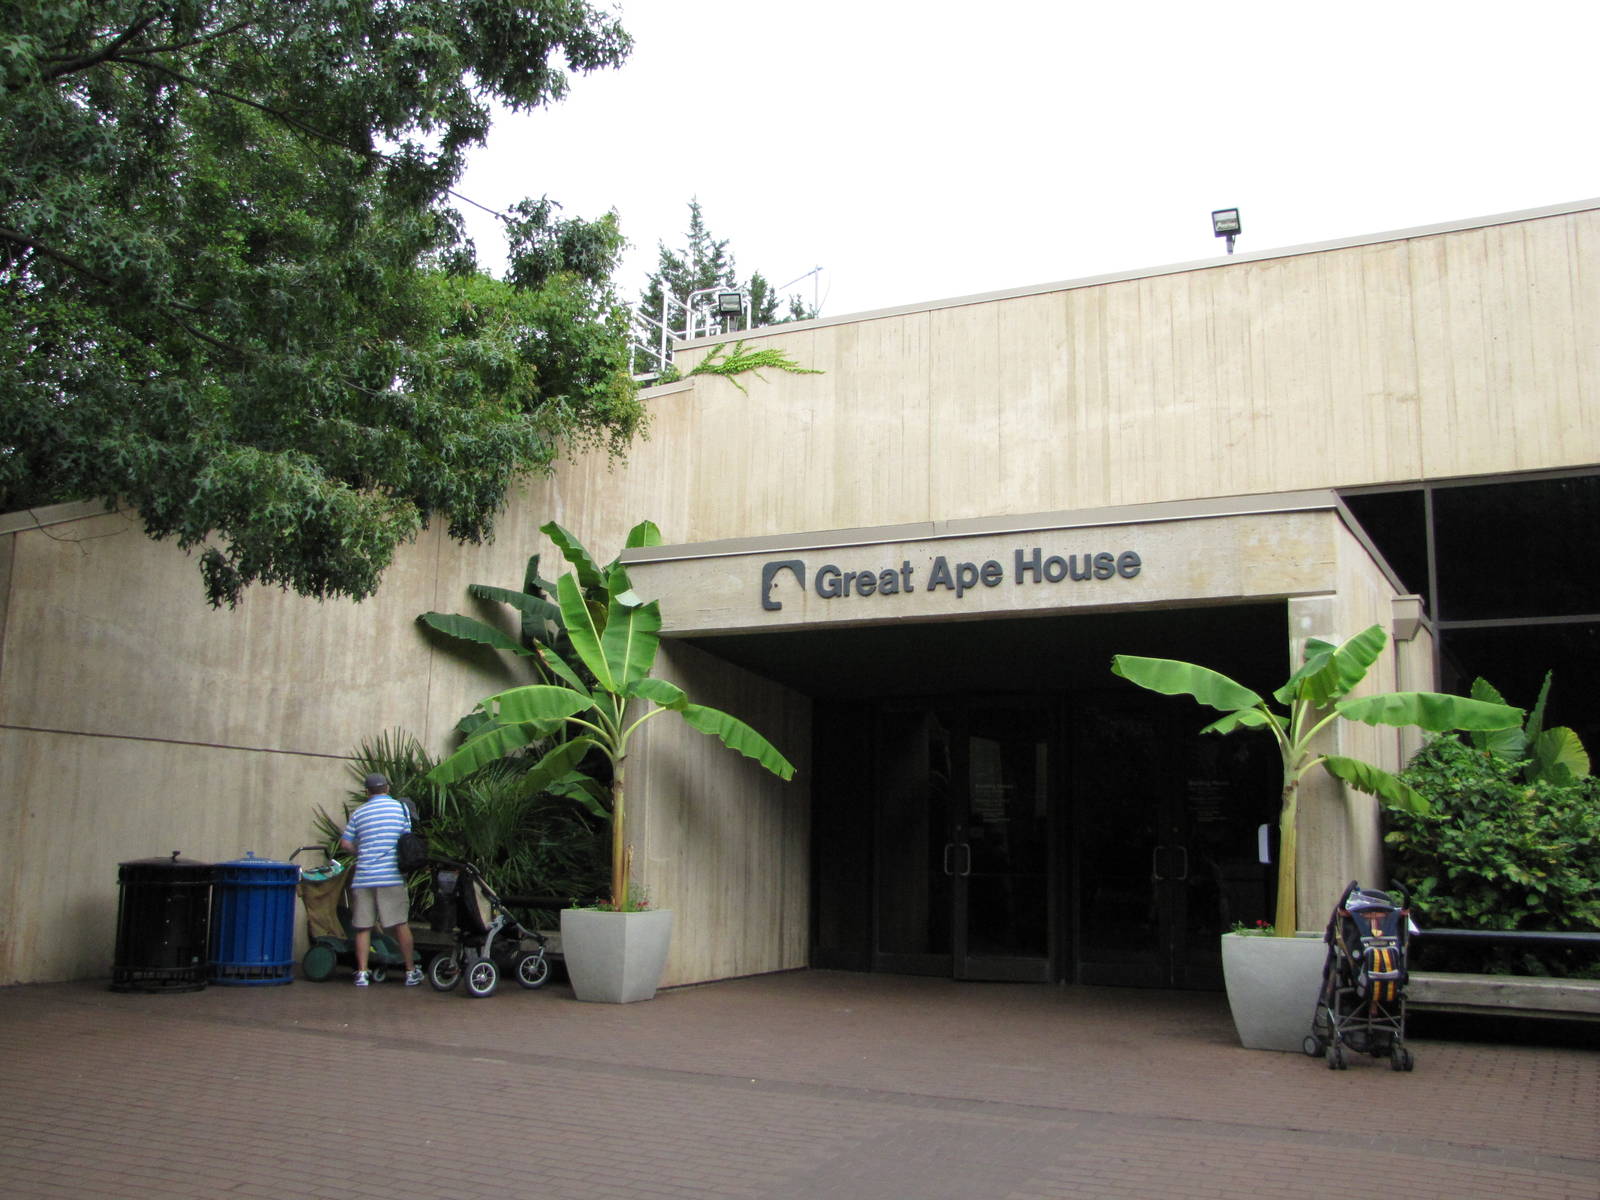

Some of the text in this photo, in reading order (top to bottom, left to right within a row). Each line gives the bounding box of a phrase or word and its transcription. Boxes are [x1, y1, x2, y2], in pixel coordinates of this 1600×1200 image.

[814, 547, 1142, 600] Great Ape House
